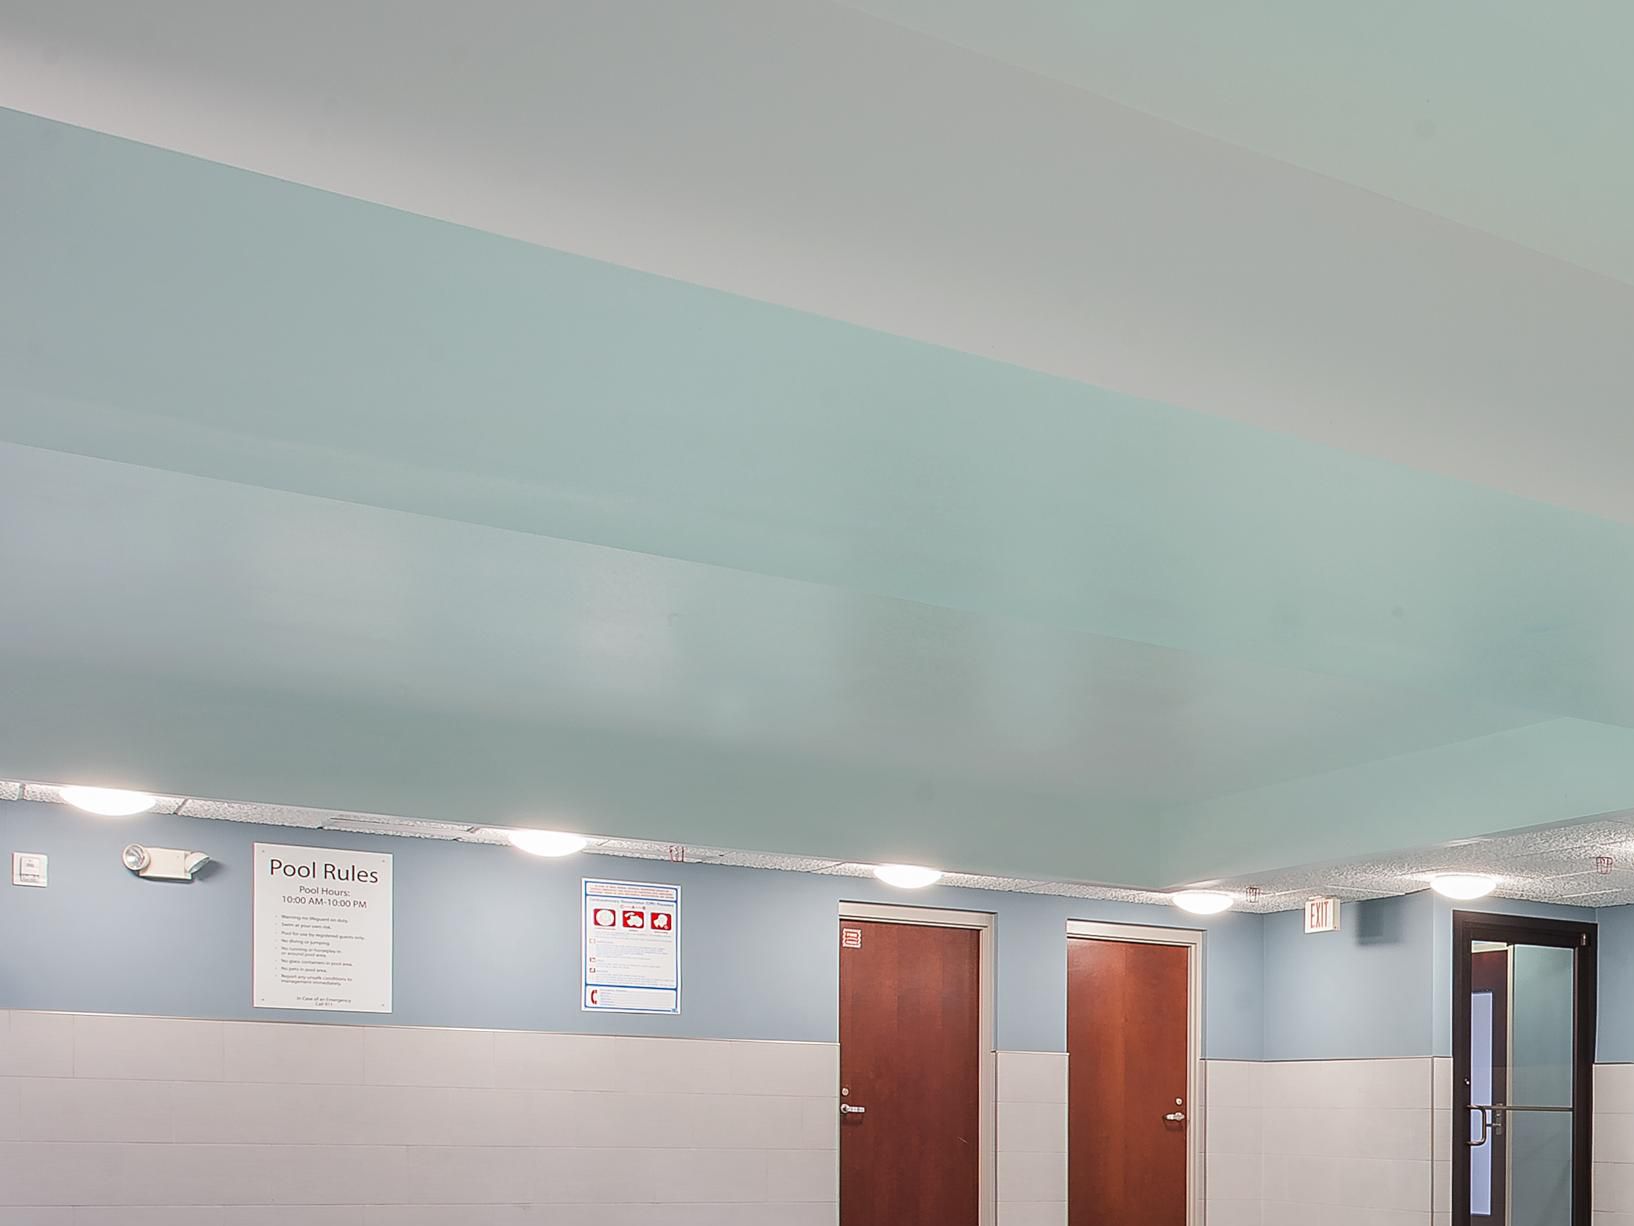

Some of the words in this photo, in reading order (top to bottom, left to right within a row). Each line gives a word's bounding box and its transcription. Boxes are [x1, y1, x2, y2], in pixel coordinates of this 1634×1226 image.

[270, 859, 316, 879] Pool
[324, 863, 378, 883] Rules
[299, 886, 319, 894] Pool
[321, 888, 351, 896] Hours:
[282, 896, 306, 904] 10:00
[309, 898, 351, 908] AM-10:00
[353, 900, 368, 908] PM
[1310, 900, 1329, 928] EXIT
